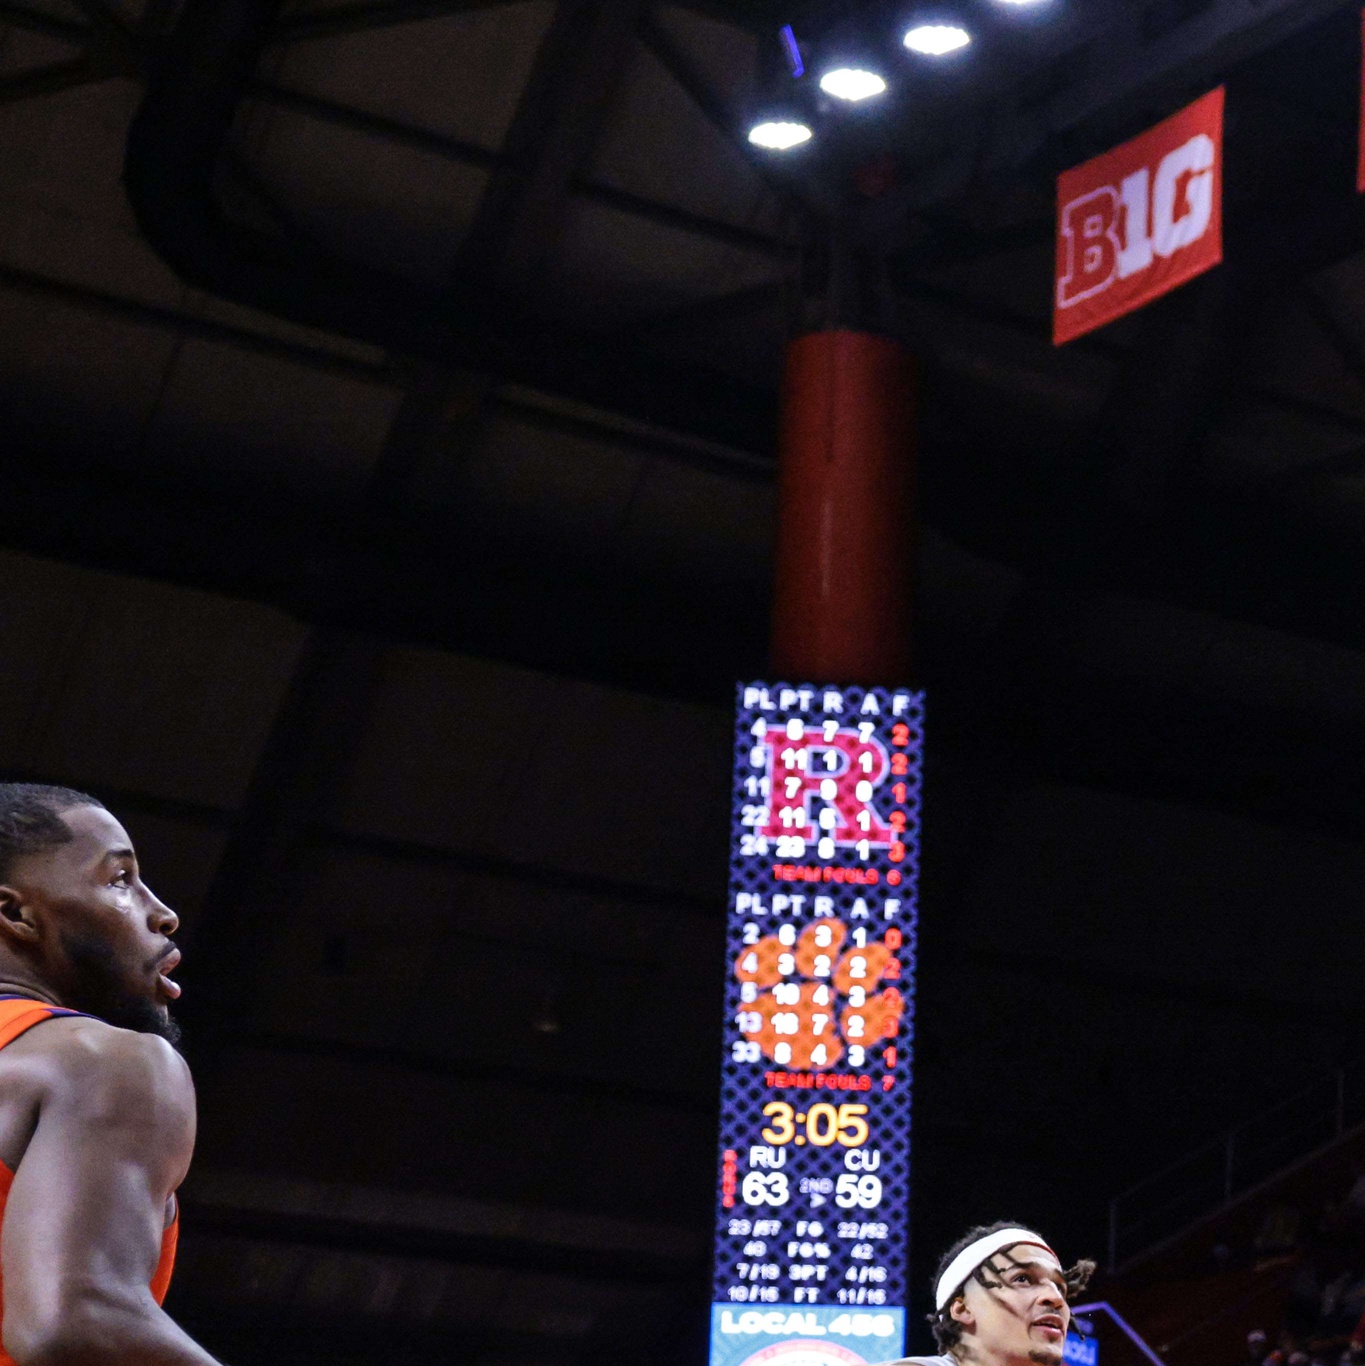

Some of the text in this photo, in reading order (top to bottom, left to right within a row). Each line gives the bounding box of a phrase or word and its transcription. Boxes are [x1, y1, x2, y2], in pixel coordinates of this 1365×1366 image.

[743, 687, 910, 716] PL PT R A F
[751, 718, 767, 737] 4
[823, 721, 839, 741] 7
[858, 722, 875, 744] 7
[892, 724, 909, 745] 2
[781, 748, 807, 770] 11
[823, 750, 837, 771] 1
[858, 752, 872, 773] 1
[891, 753, 909, 775] 2
[744, 776, 769, 796] 11
[785, 778, 801, 798] 7
[892, 782, 905, 804] 1
[741, 805, 770, 826] 22
[779, 806, 805, 828] 11
[856, 810, 870, 831] 1
[740, 834, 768, 855] 24
[855, 839, 869, 860] 1
[772, 865, 821, 882] TEAM
[823, 866, 878, 884] FOULS
[735, 892, 901, 919] PL PT R A F
[742, 923, 759, 944] 2
[814, 925, 832, 947] 3
[852, 927, 866, 948] 1
[742, 952, 901, 979] 4 3 2 2 2
[813, 985, 829, 1006] 4
[849, 986, 866, 1007] 3
[812, 1014, 828, 1035] 7
[848, 1015, 864, 1037] 2
[810, 1044, 827, 1065] 4
[848, 1046, 865, 1067] 3
[883, 1047, 897, 1068] 1
[765, 1072, 895, 1091] TEAM FOULS 7
[762, 1102, 870, 1147] 3:05
[750, 1146, 880, 1171] RU CU
[742, 1171, 882, 1209] 63 2ND 59
[788, 1264, 828, 1281] 3PT
[794, 1288, 820, 1303] FT
[721, 1311, 826, 1335] LOCAL
